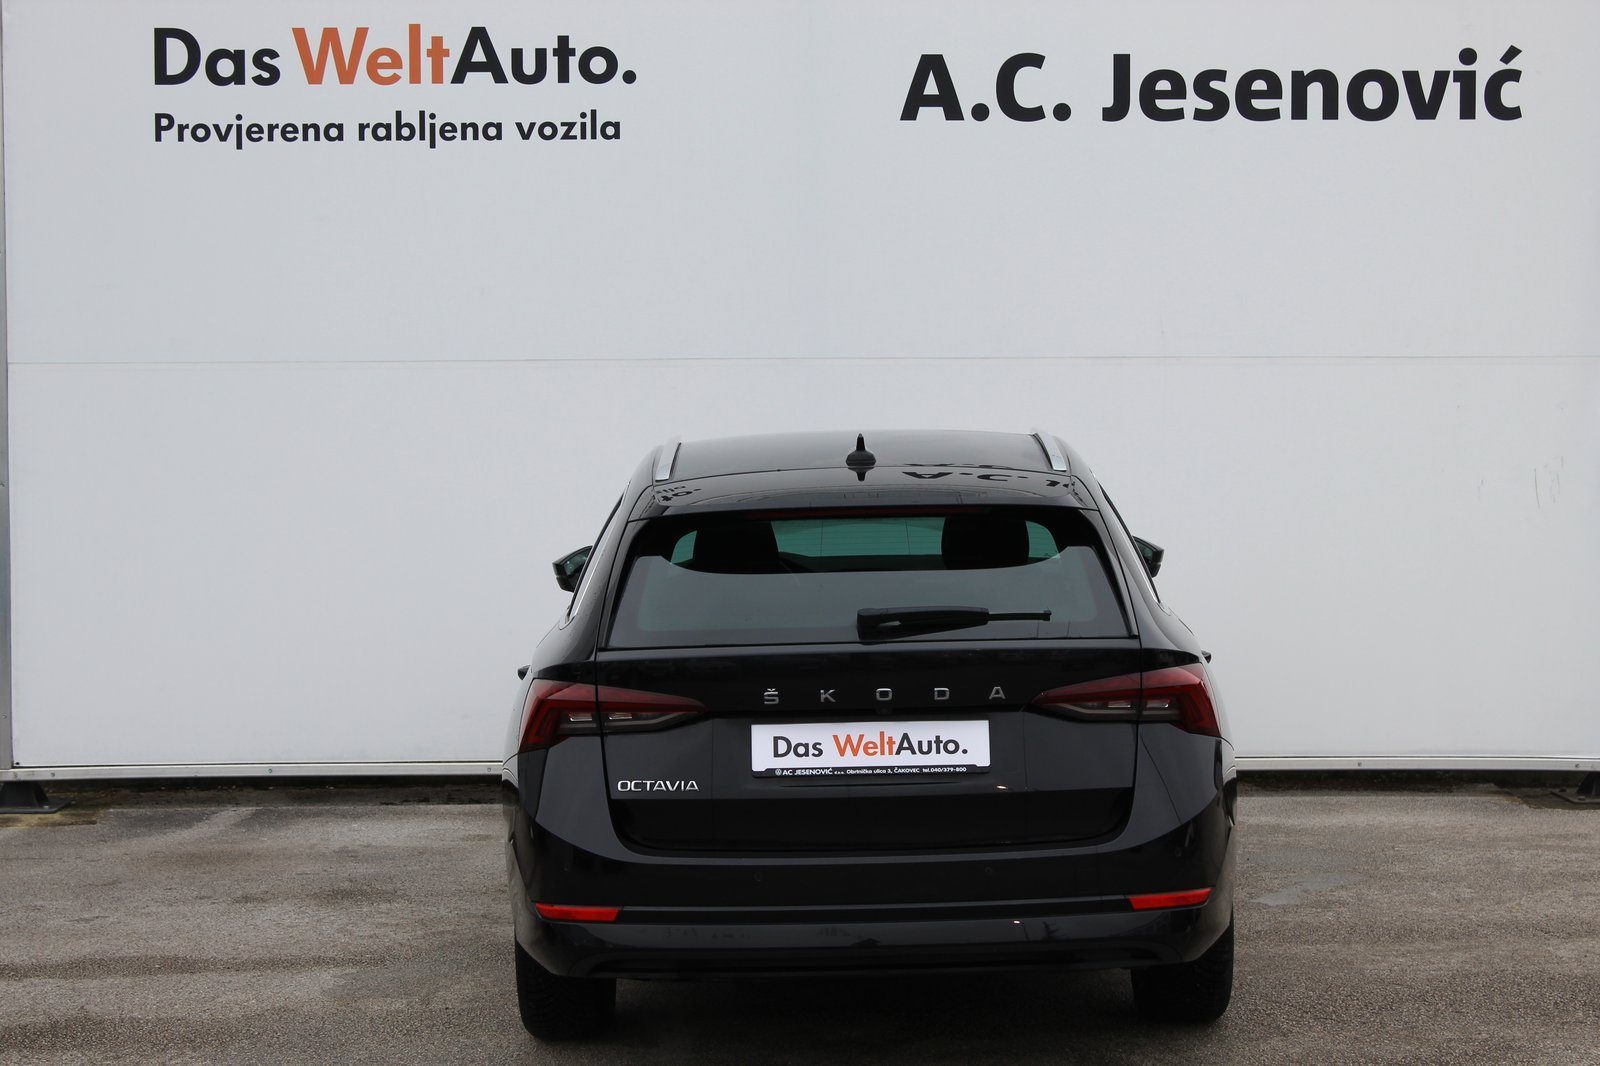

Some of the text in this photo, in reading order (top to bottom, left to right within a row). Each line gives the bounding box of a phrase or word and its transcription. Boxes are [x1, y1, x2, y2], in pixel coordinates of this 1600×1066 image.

[154, 24, 637, 86] Das WeltAuto.
[900, 45, 1523, 122] A.C. Jesenović
[155, 109, 621, 150] Provjerena rabljena vozila
[763, 686, 1006, 705] ŠKODA
[772, 731, 968, 758] Das WeltAuto.
[794, 767, 833, 776] JESENOVIĆ
[617, 780, 700, 792] OCTAVIA
